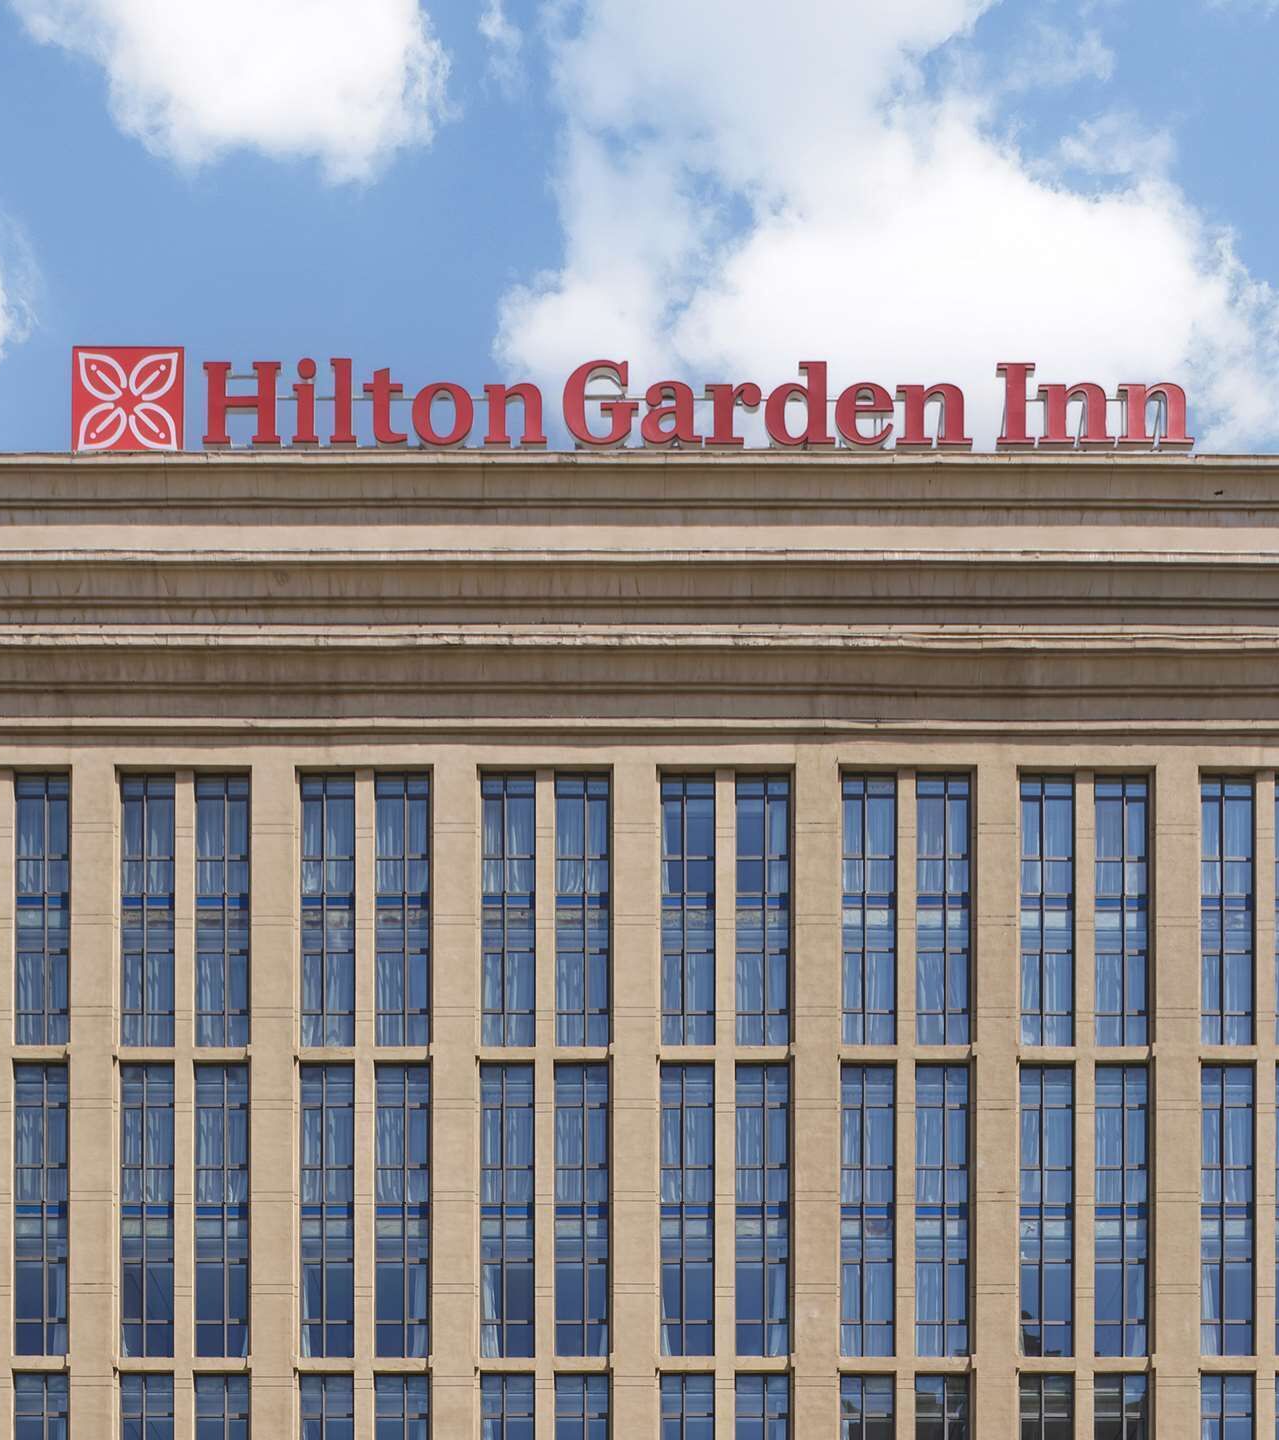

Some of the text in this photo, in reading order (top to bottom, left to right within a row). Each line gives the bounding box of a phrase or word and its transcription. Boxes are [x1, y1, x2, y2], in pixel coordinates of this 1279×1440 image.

[202, 357, 1195, 447] Hilton Garden Inn
